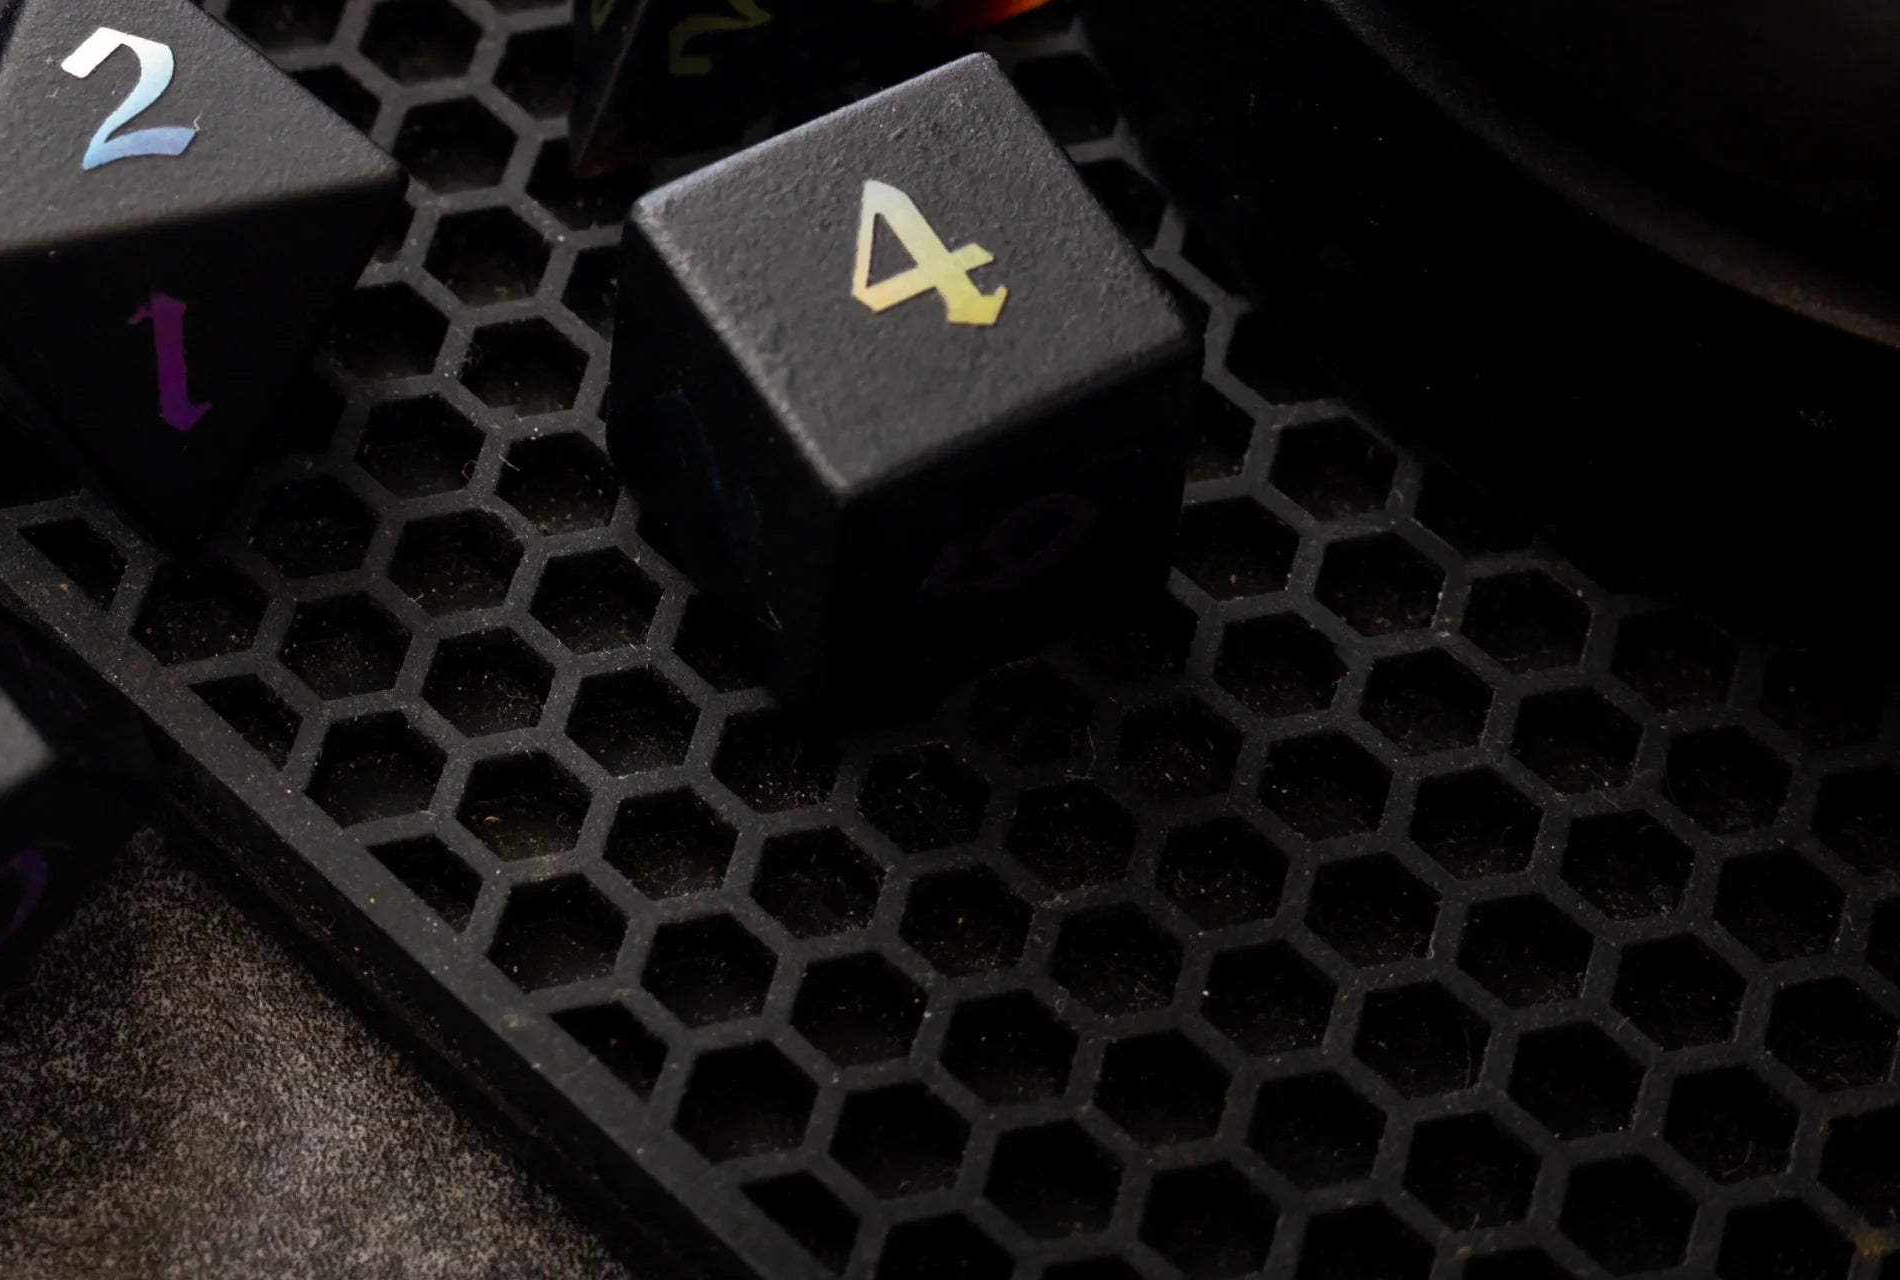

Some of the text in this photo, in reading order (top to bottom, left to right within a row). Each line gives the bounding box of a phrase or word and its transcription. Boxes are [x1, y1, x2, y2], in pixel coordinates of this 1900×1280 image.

[61, 26, 197, 170] 2
[852, 179, 1008, 326] 4
[127, 291, 212, 433] 1
